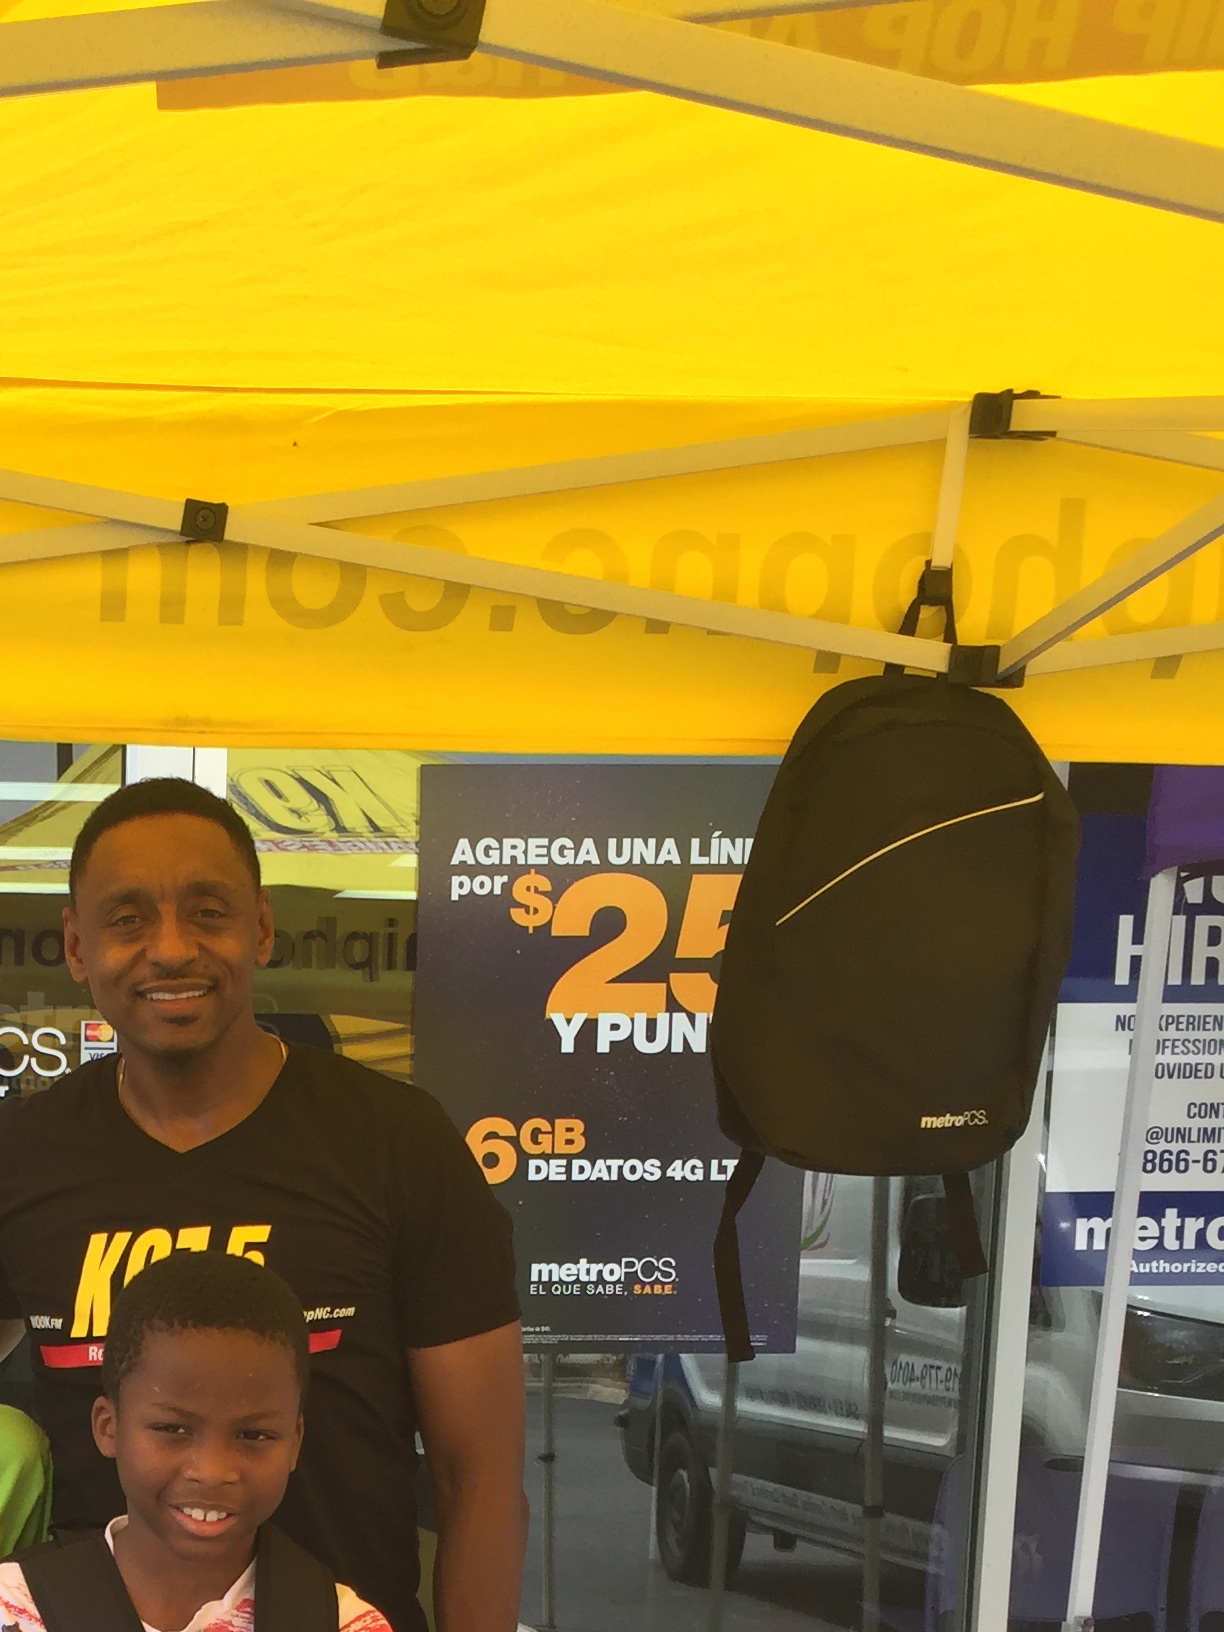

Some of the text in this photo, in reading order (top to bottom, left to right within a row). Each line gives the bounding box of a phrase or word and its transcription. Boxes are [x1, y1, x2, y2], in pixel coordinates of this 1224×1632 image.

[450, 838, 600, 865] AGREGA
[607, 838, 681, 865] UNA
[450, 874, 508, 900] por
[550, 1013, 713, 1053] Y PUN
[1154, 1062, 1215, 1079] OVIDED
[1145, 1126, 1224, 1145] @UNLIMI
[528, 1159, 566, 1181] DE
[571, 1159, 662, 1181] DATOS
[666, 1159, 704, 1181] 4G
[529, 1284, 546, 1295] EL
[551, 1284, 581, 1295] QUE
[633, 1284, 677, 1295] SABE.
[303, 1307, 355, 1323] pNC.com
